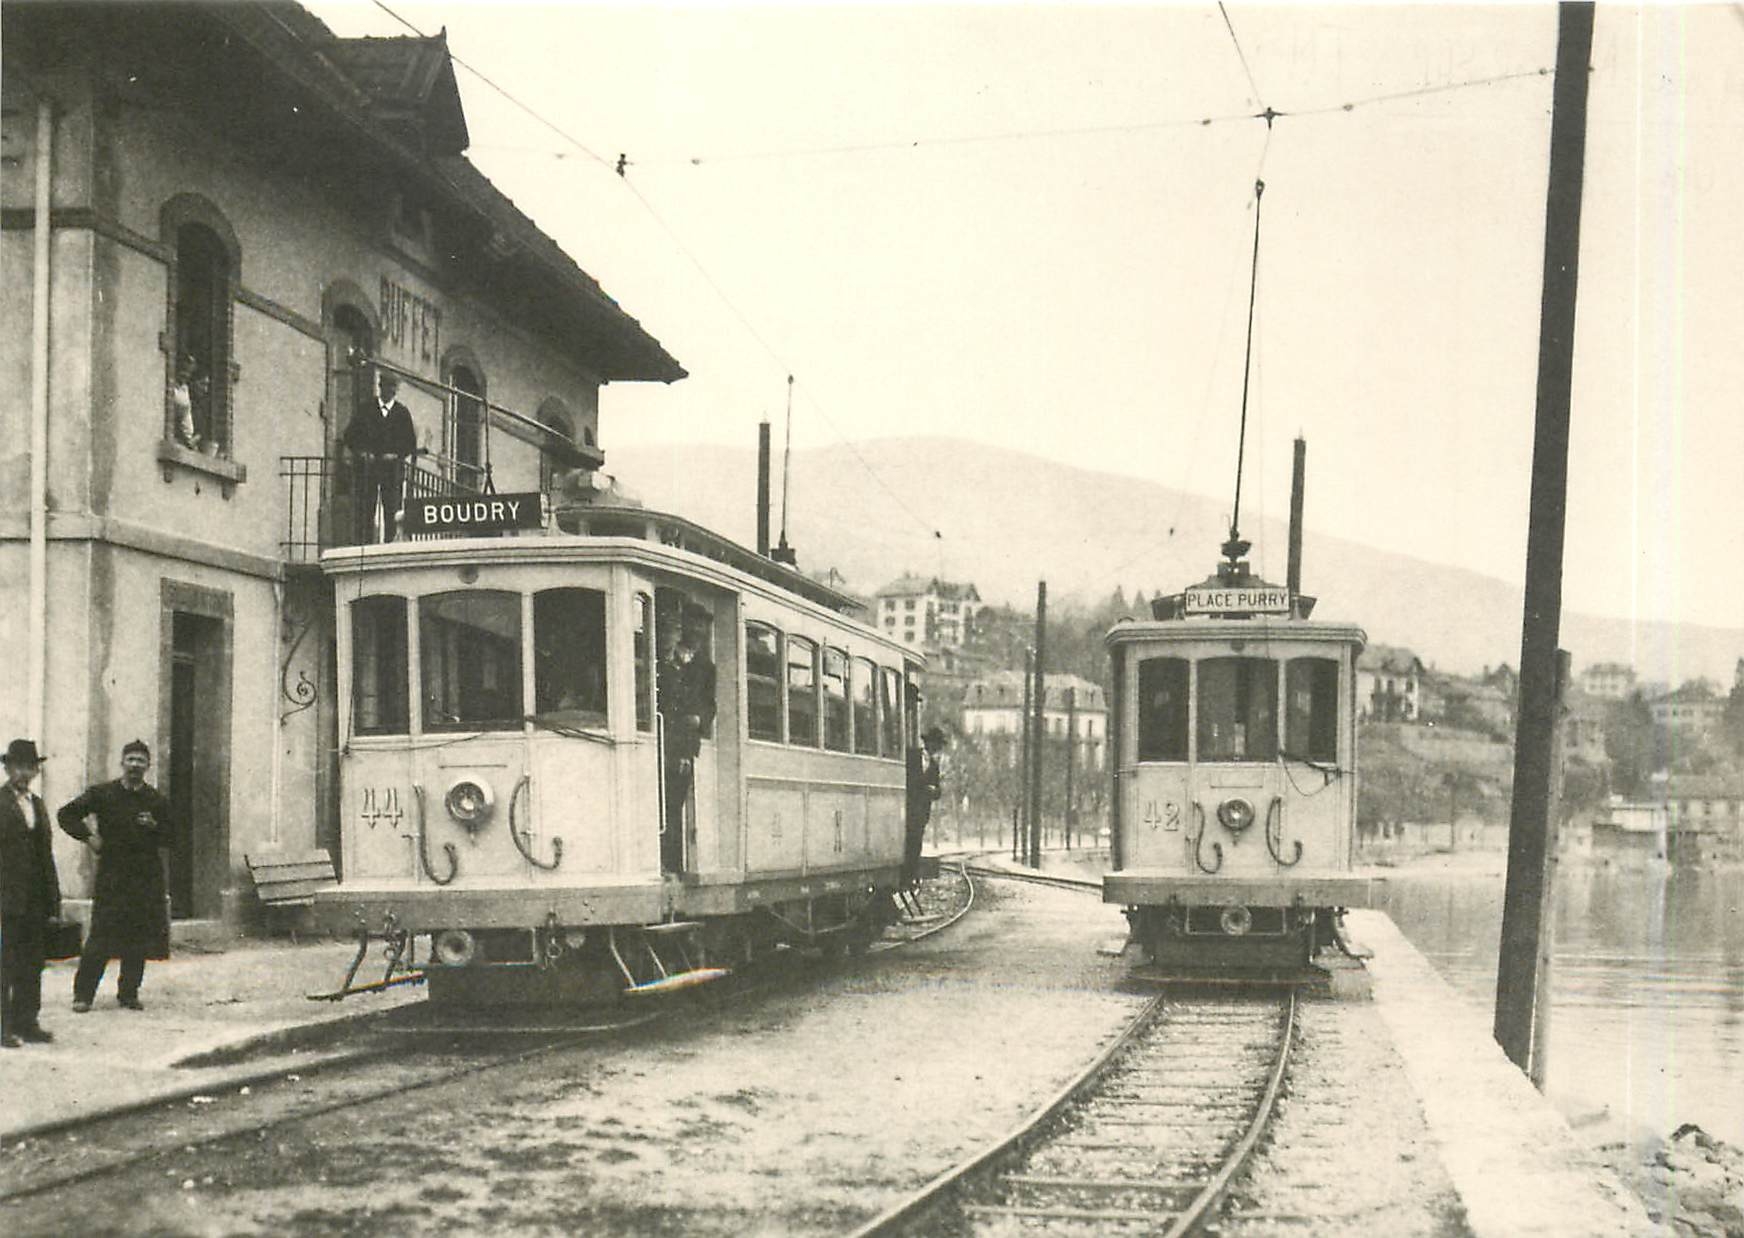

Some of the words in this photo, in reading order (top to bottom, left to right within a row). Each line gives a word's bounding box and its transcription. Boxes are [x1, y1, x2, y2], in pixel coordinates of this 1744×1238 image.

[381, 274, 439, 368] BUFFET
[424, 501, 519, 524] BOUDRY
[1187, 593, 1233, 608] PLACE
[1238, 592, 1287, 607] PURRY
[360, 787, 403, 829] 44
[1143, 800, 1180, 832] 42
